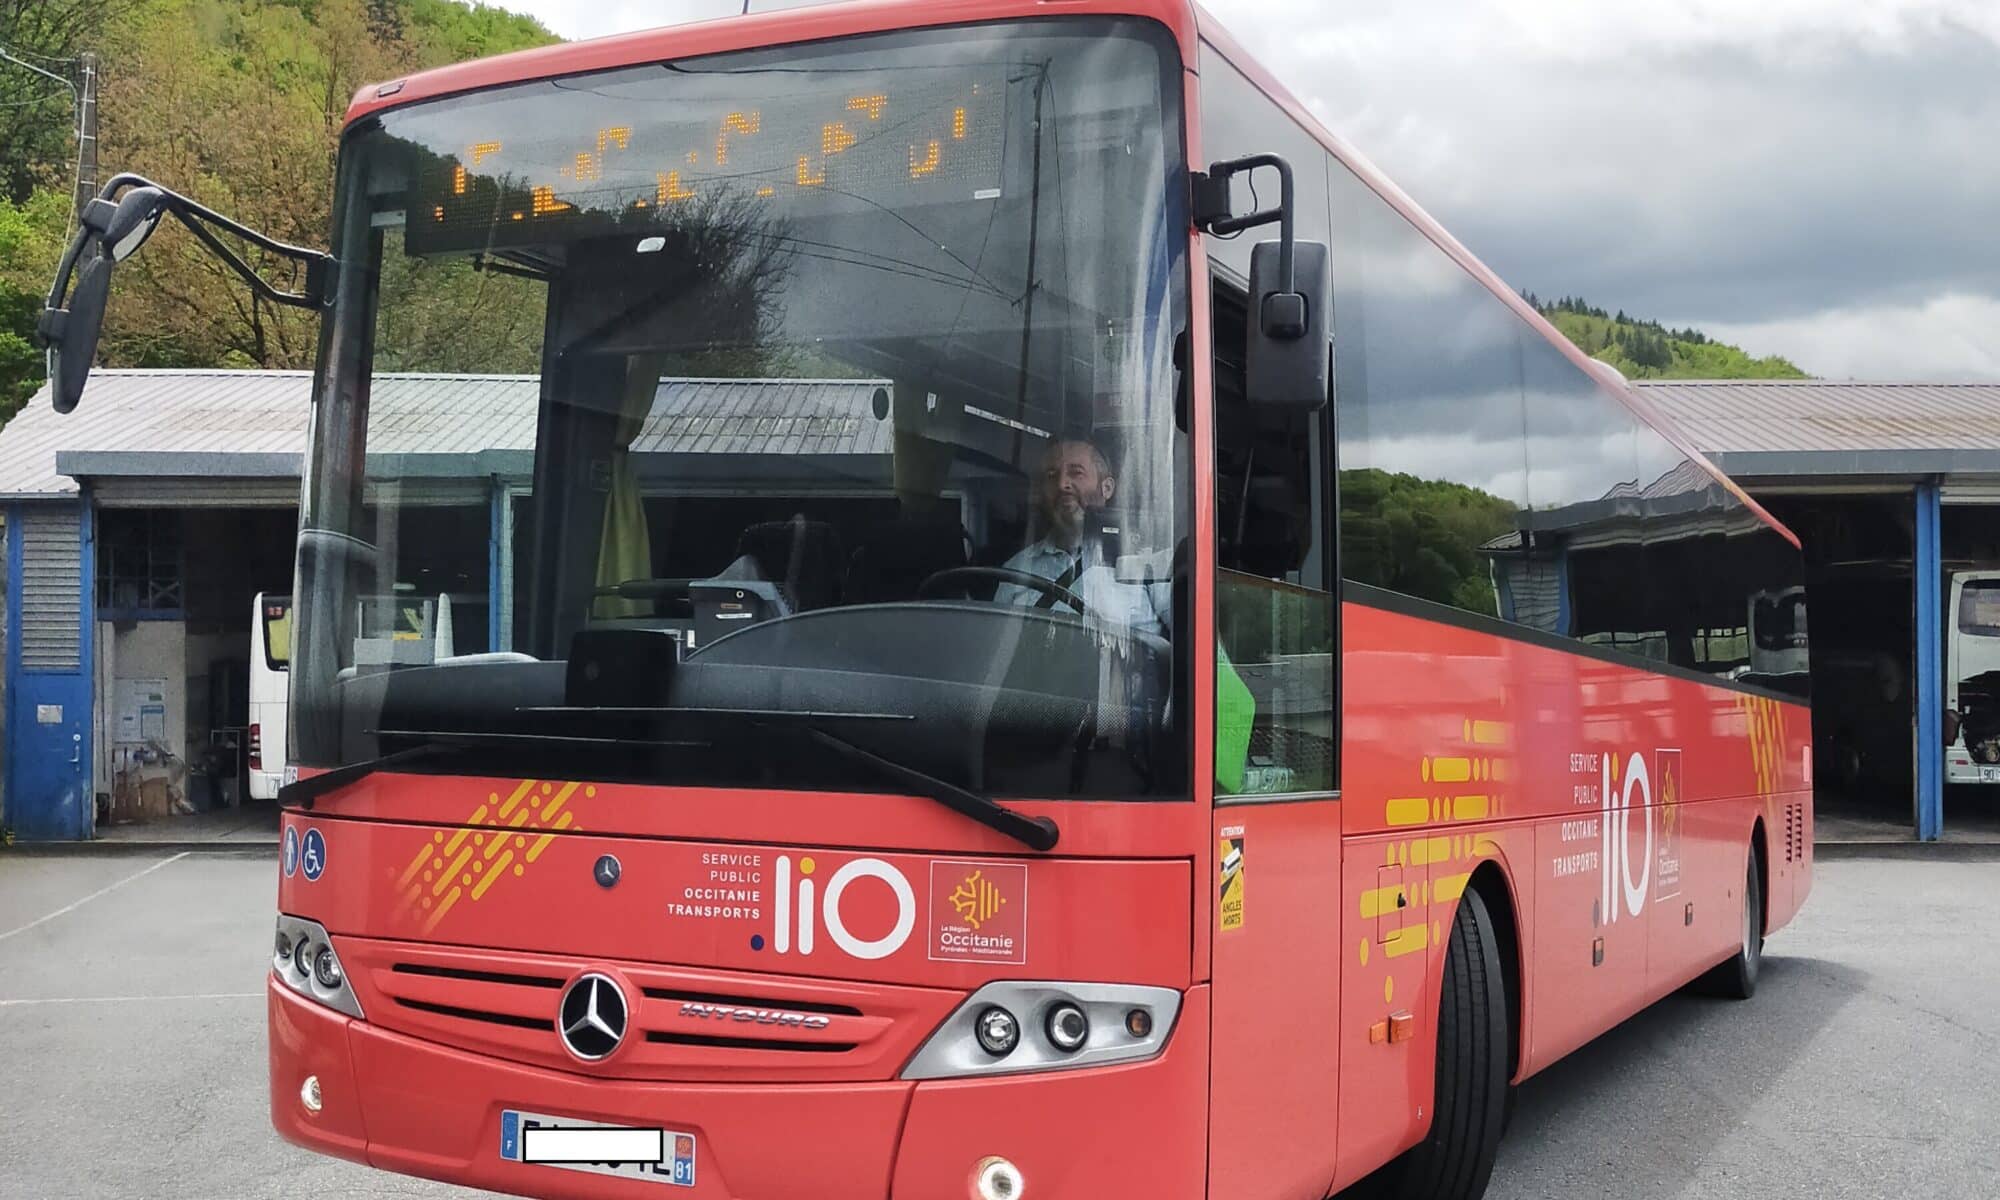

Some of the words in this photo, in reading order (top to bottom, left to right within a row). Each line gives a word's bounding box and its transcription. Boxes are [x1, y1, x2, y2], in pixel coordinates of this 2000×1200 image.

[1570, 753, 1598, 773] SERVICE
[1574, 785, 1598, 804] PUBLIC
[1562, 819, 1598, 842] OCCITANIE
[702, 853, 761, 867] SERVICE
[1553, 851, 1598, 878] TRANSPORTS
[710, 870, 761, 883] PUBLIC
[684, 887, 761, 902] OCCITANIE
[667, 903, 761, 919] TRANSPORTS
[1223, 899, 1242, 913] ANGLES
[1223, 912, 1241, 926] MORTS
[949, 925, 971, 933] Région
[940, 932, 1013, 948] Occitanie
[679, 1002, 830, 1029] INTOURO
[506, 1139, 512, 1151] F
[675, 1160, 692, 1180] 81
